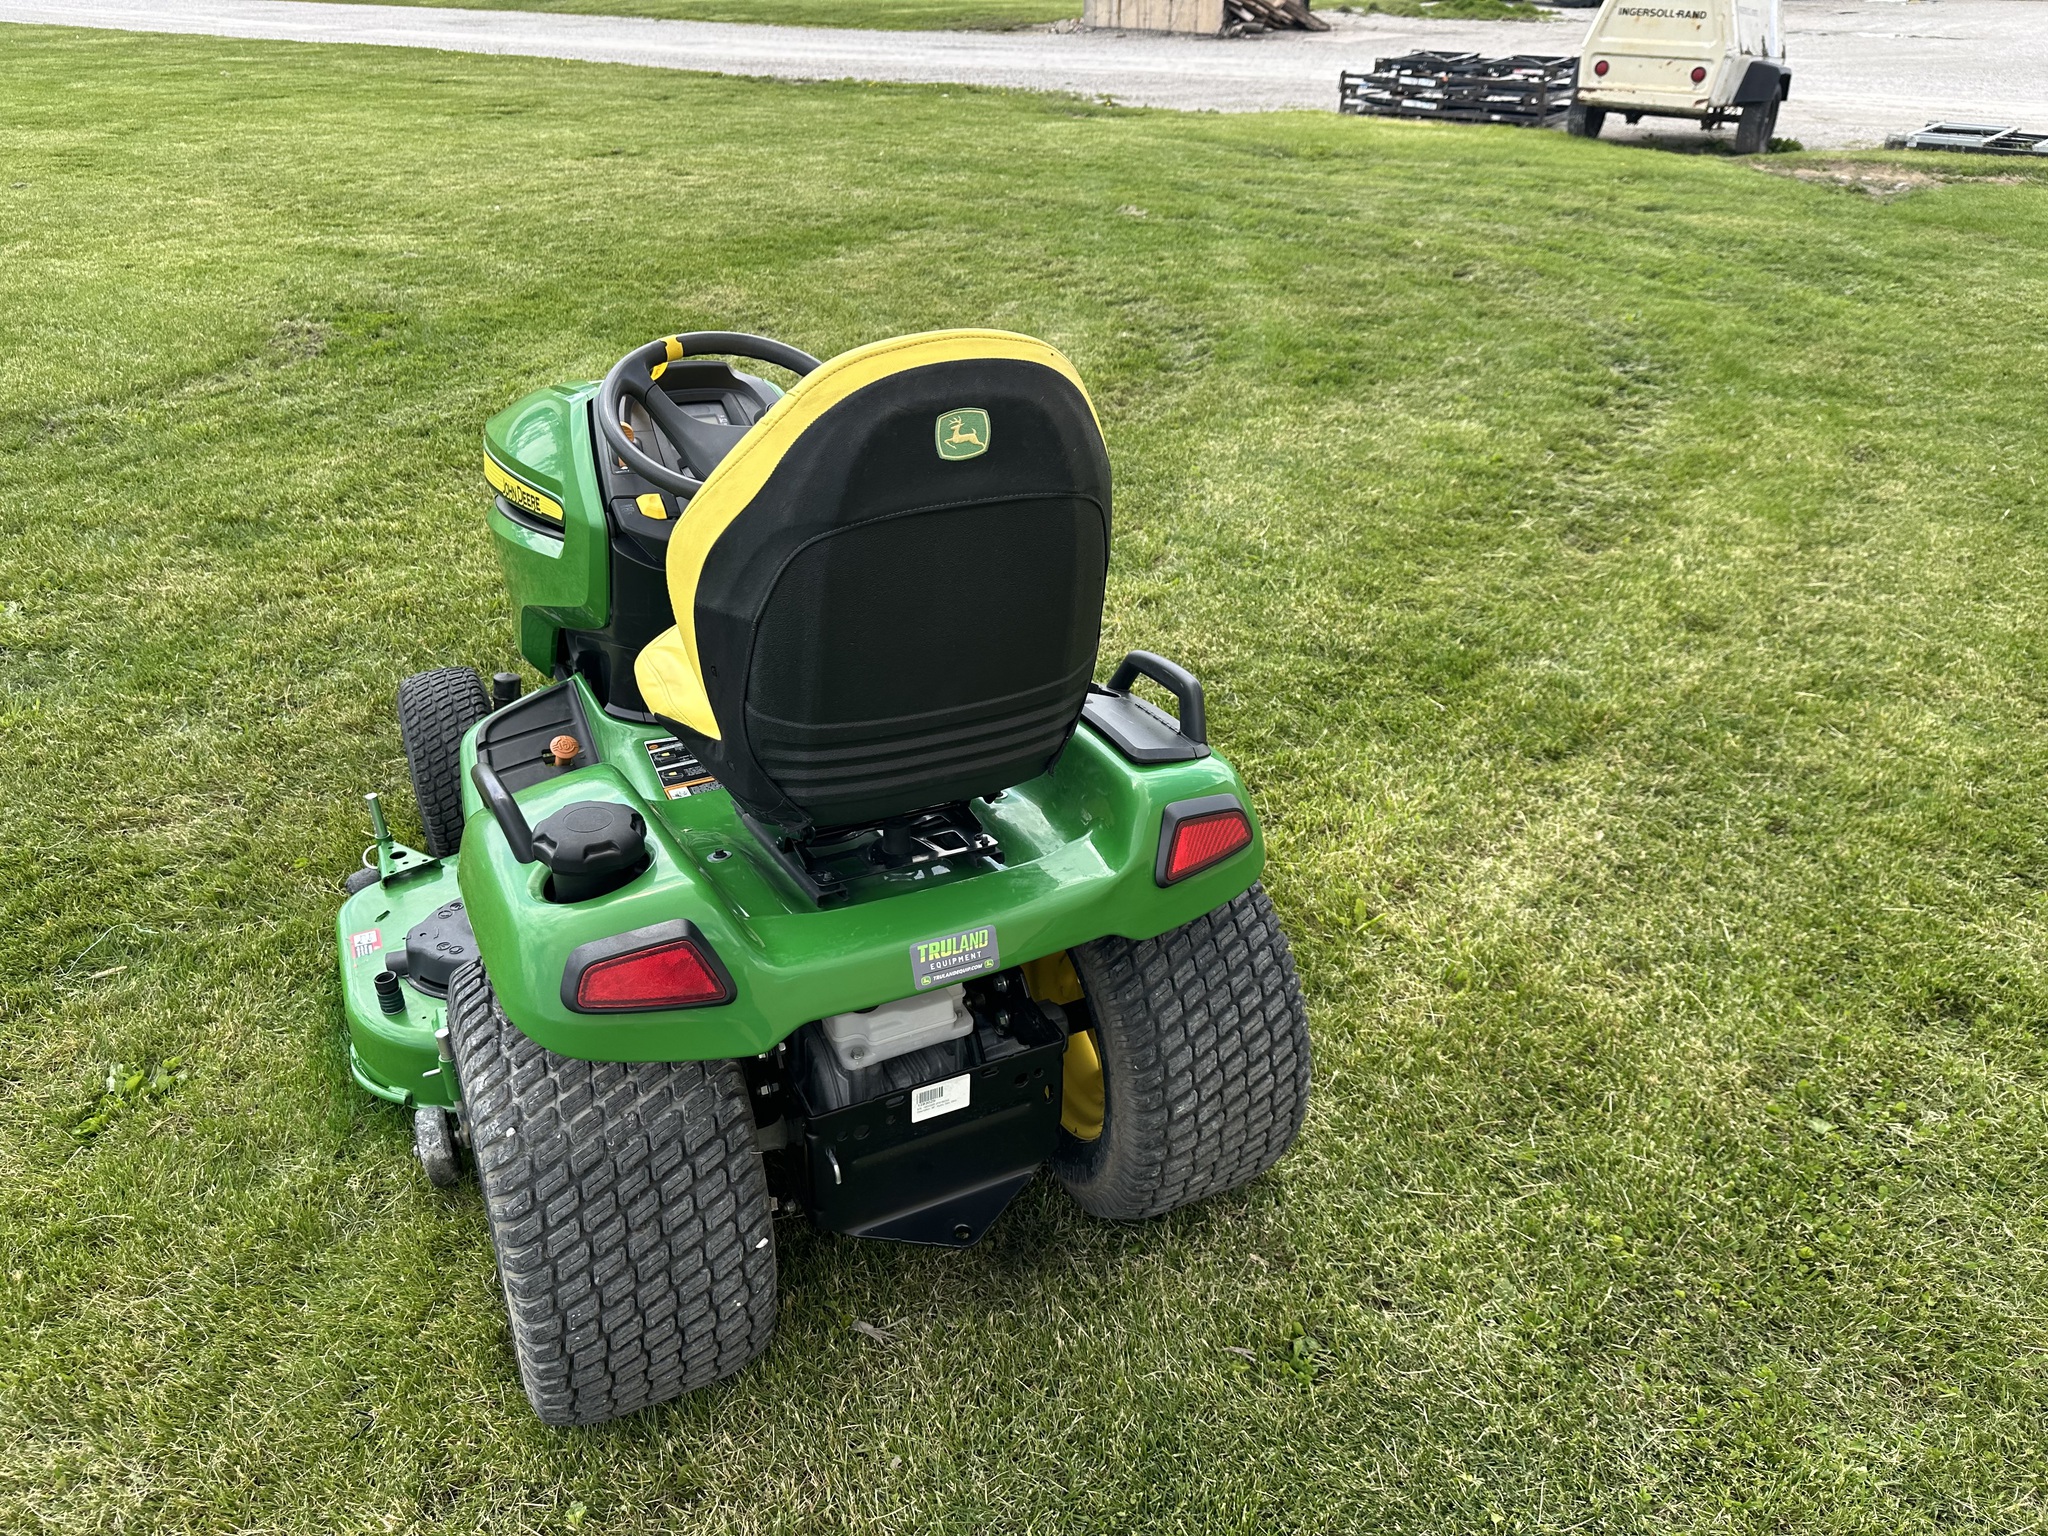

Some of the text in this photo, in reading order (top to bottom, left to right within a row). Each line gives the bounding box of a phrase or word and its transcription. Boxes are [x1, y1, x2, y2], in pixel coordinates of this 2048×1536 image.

[1618, 7, 1707, 19] INGERSOLL-RAND
[516, 485, 541, 511] DEERE
[917, 929, 989, 963] TRULAND
[930, 951, 982, 970] EQUIPMENT
[933, 963, 983, 980] TRULANDEQUIP.COM
